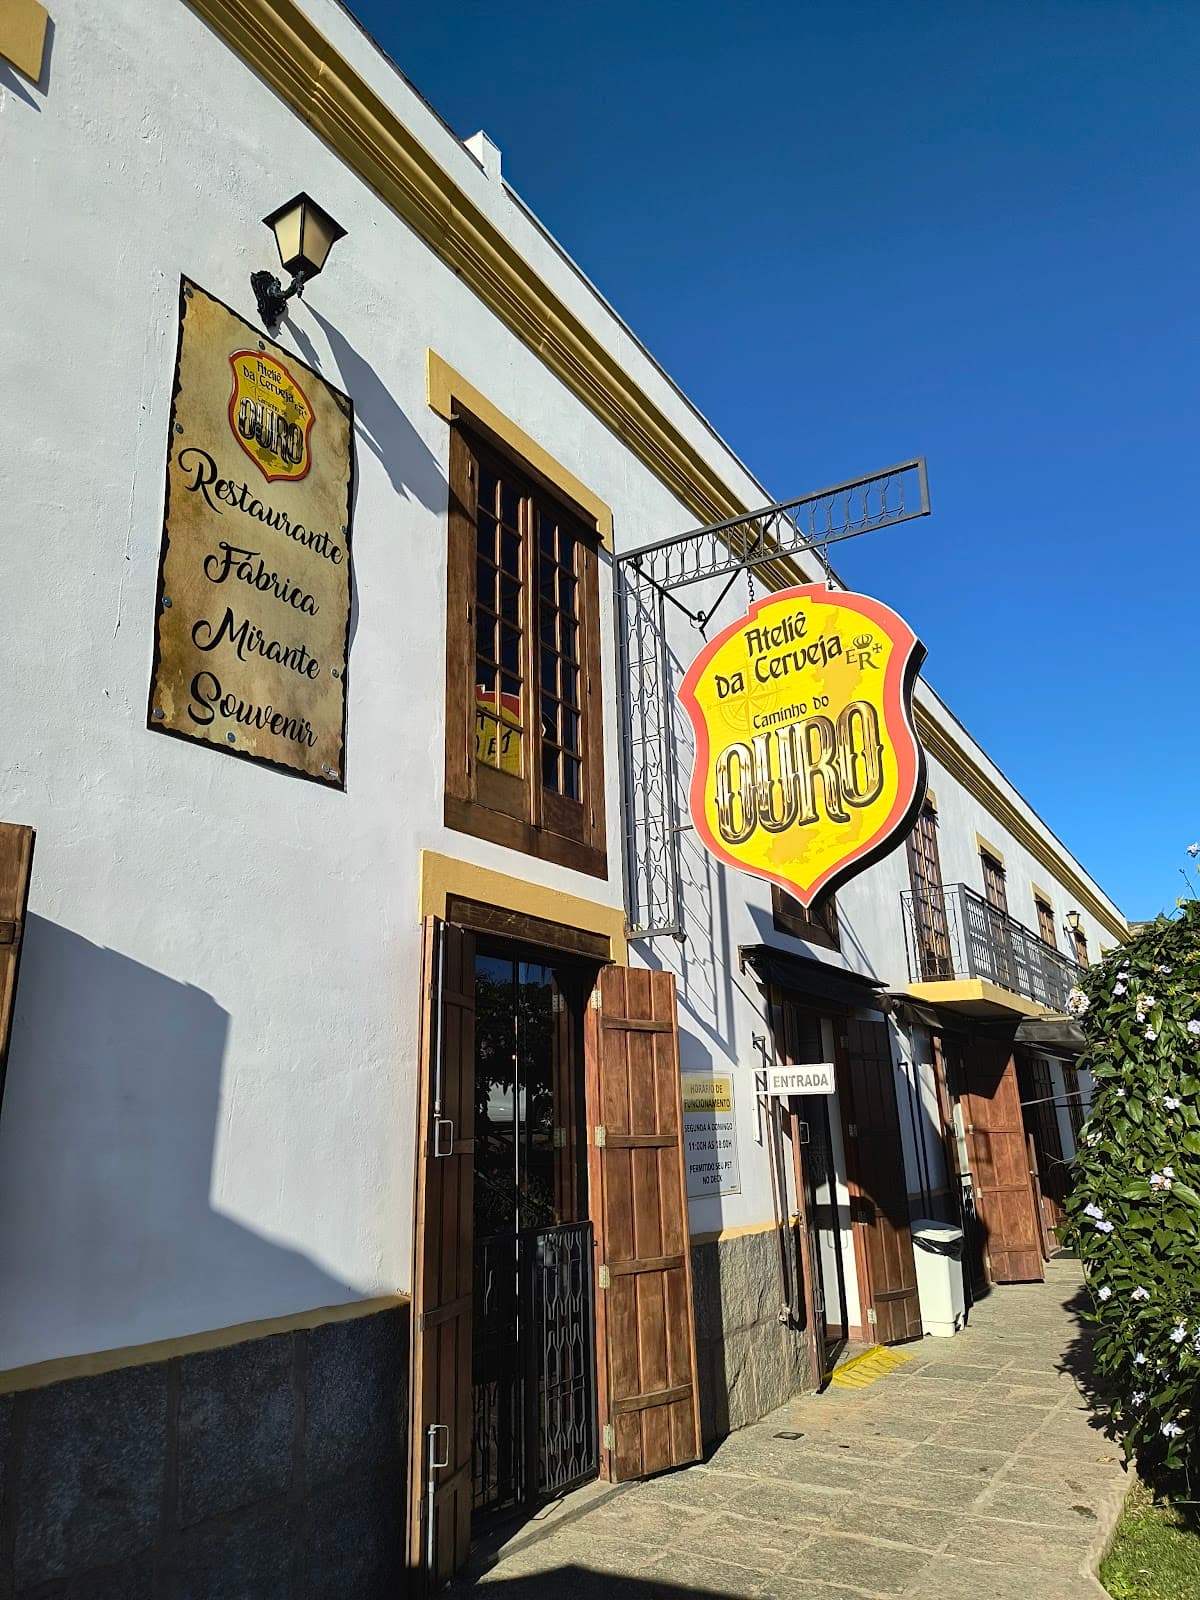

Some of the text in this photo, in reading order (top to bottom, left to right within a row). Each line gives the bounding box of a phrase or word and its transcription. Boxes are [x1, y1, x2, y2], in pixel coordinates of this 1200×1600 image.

[239, 397, 304, 465] OURO
[178, 448, 343, 565] Restaurante
[204, 541, 320, 617] Fábrica
[191, 606, 321, 680] Mirante
[744, 611, 808, 657] Ateliê
[754, 634, 843, 683] Cerveja
[188, 671, 318, 747] Souvenir
[753, 704, 808, 729] Caminho
[714, 700, 884, 844] OURO
[684, 1098, 731, 1108] FUNCIONAMENTO
[715, 1084, 723, 1093] DE
[773, 1073, 829, 1088] ENTRADA
[685, 1123, 706, 1132] SEGUNDA
[690, 1163, 714, 1173] PERMITIDO
[702, 1175, 710, 1184] NO
